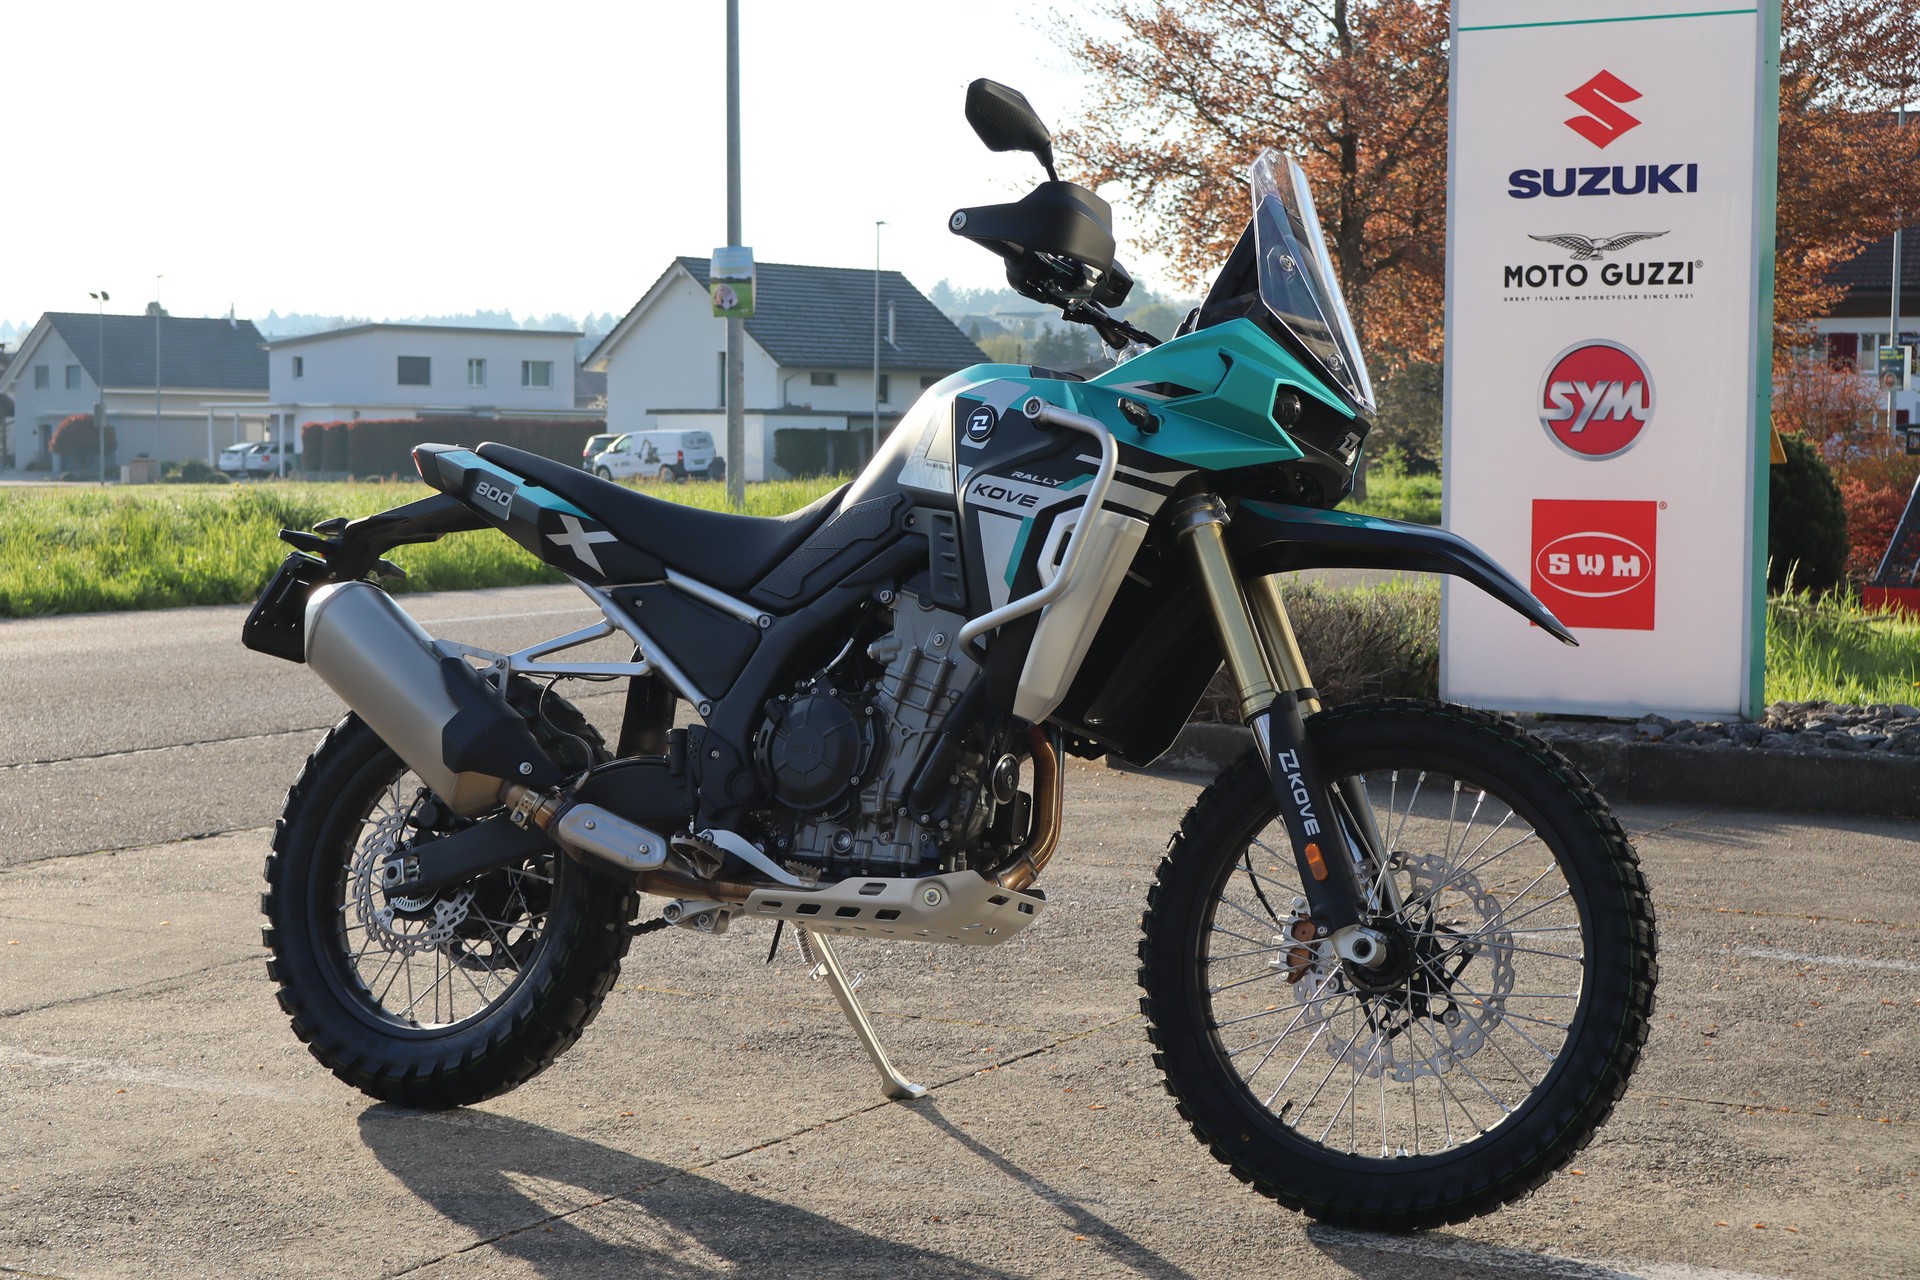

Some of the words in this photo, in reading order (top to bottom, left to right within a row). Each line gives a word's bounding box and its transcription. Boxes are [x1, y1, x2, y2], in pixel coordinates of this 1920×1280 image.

[1507, 163, 1698, 199] SUZUKI
[1504, 264, 1588, 288] MOTO
[1540, 380, 1650, 432] SYM
[1011, 471, 1064, 486] RALLY
[475, 481, 513, 507] 800
[972, 483, 1039, 508] KOVE
[1287, 772, 1321, 837] KOVE
